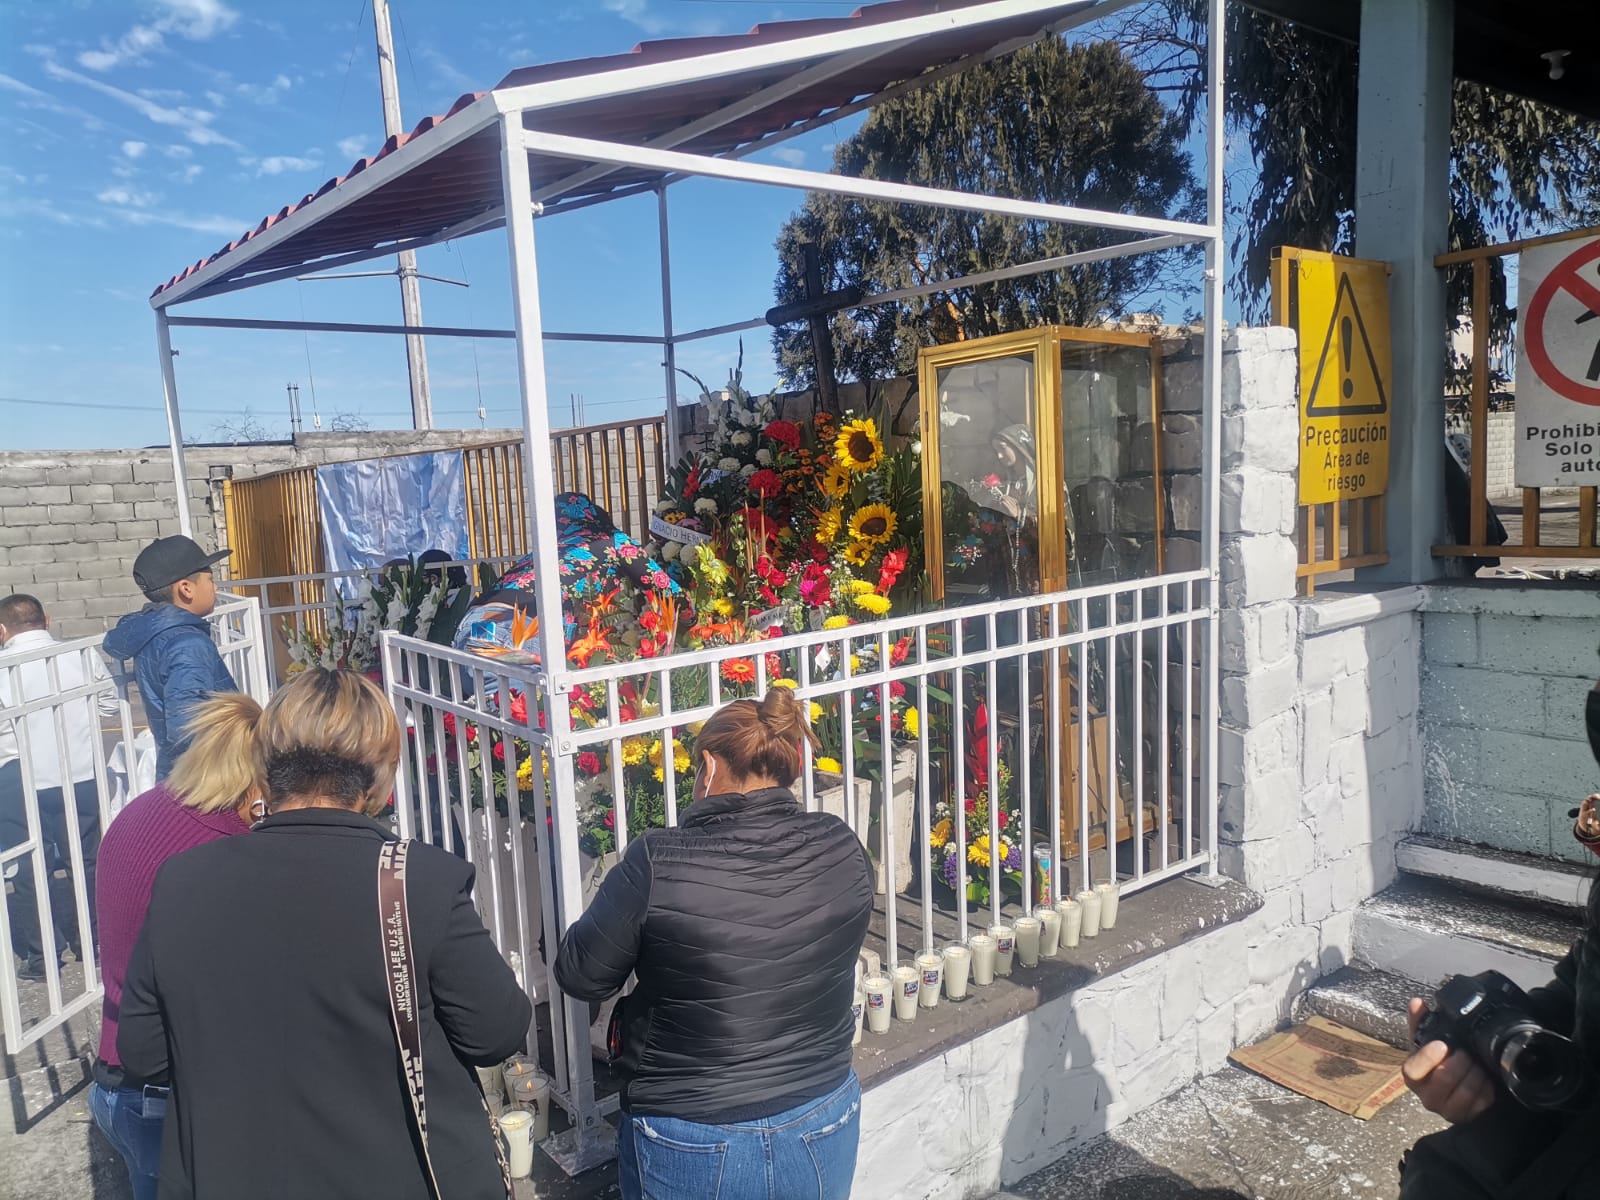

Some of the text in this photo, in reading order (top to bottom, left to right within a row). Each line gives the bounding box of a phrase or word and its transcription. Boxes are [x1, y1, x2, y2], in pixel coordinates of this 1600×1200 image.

[1306, 421, 1387, 447] Precaución
[1324, 447, 1370, 470] Área de
[1545, 441, 1592, 456] Solo
[1328, 473, 1366, 492] riesgo
[391, 950, 401, 969] LEE
[394, 971, 406, 1011] NICOLE
